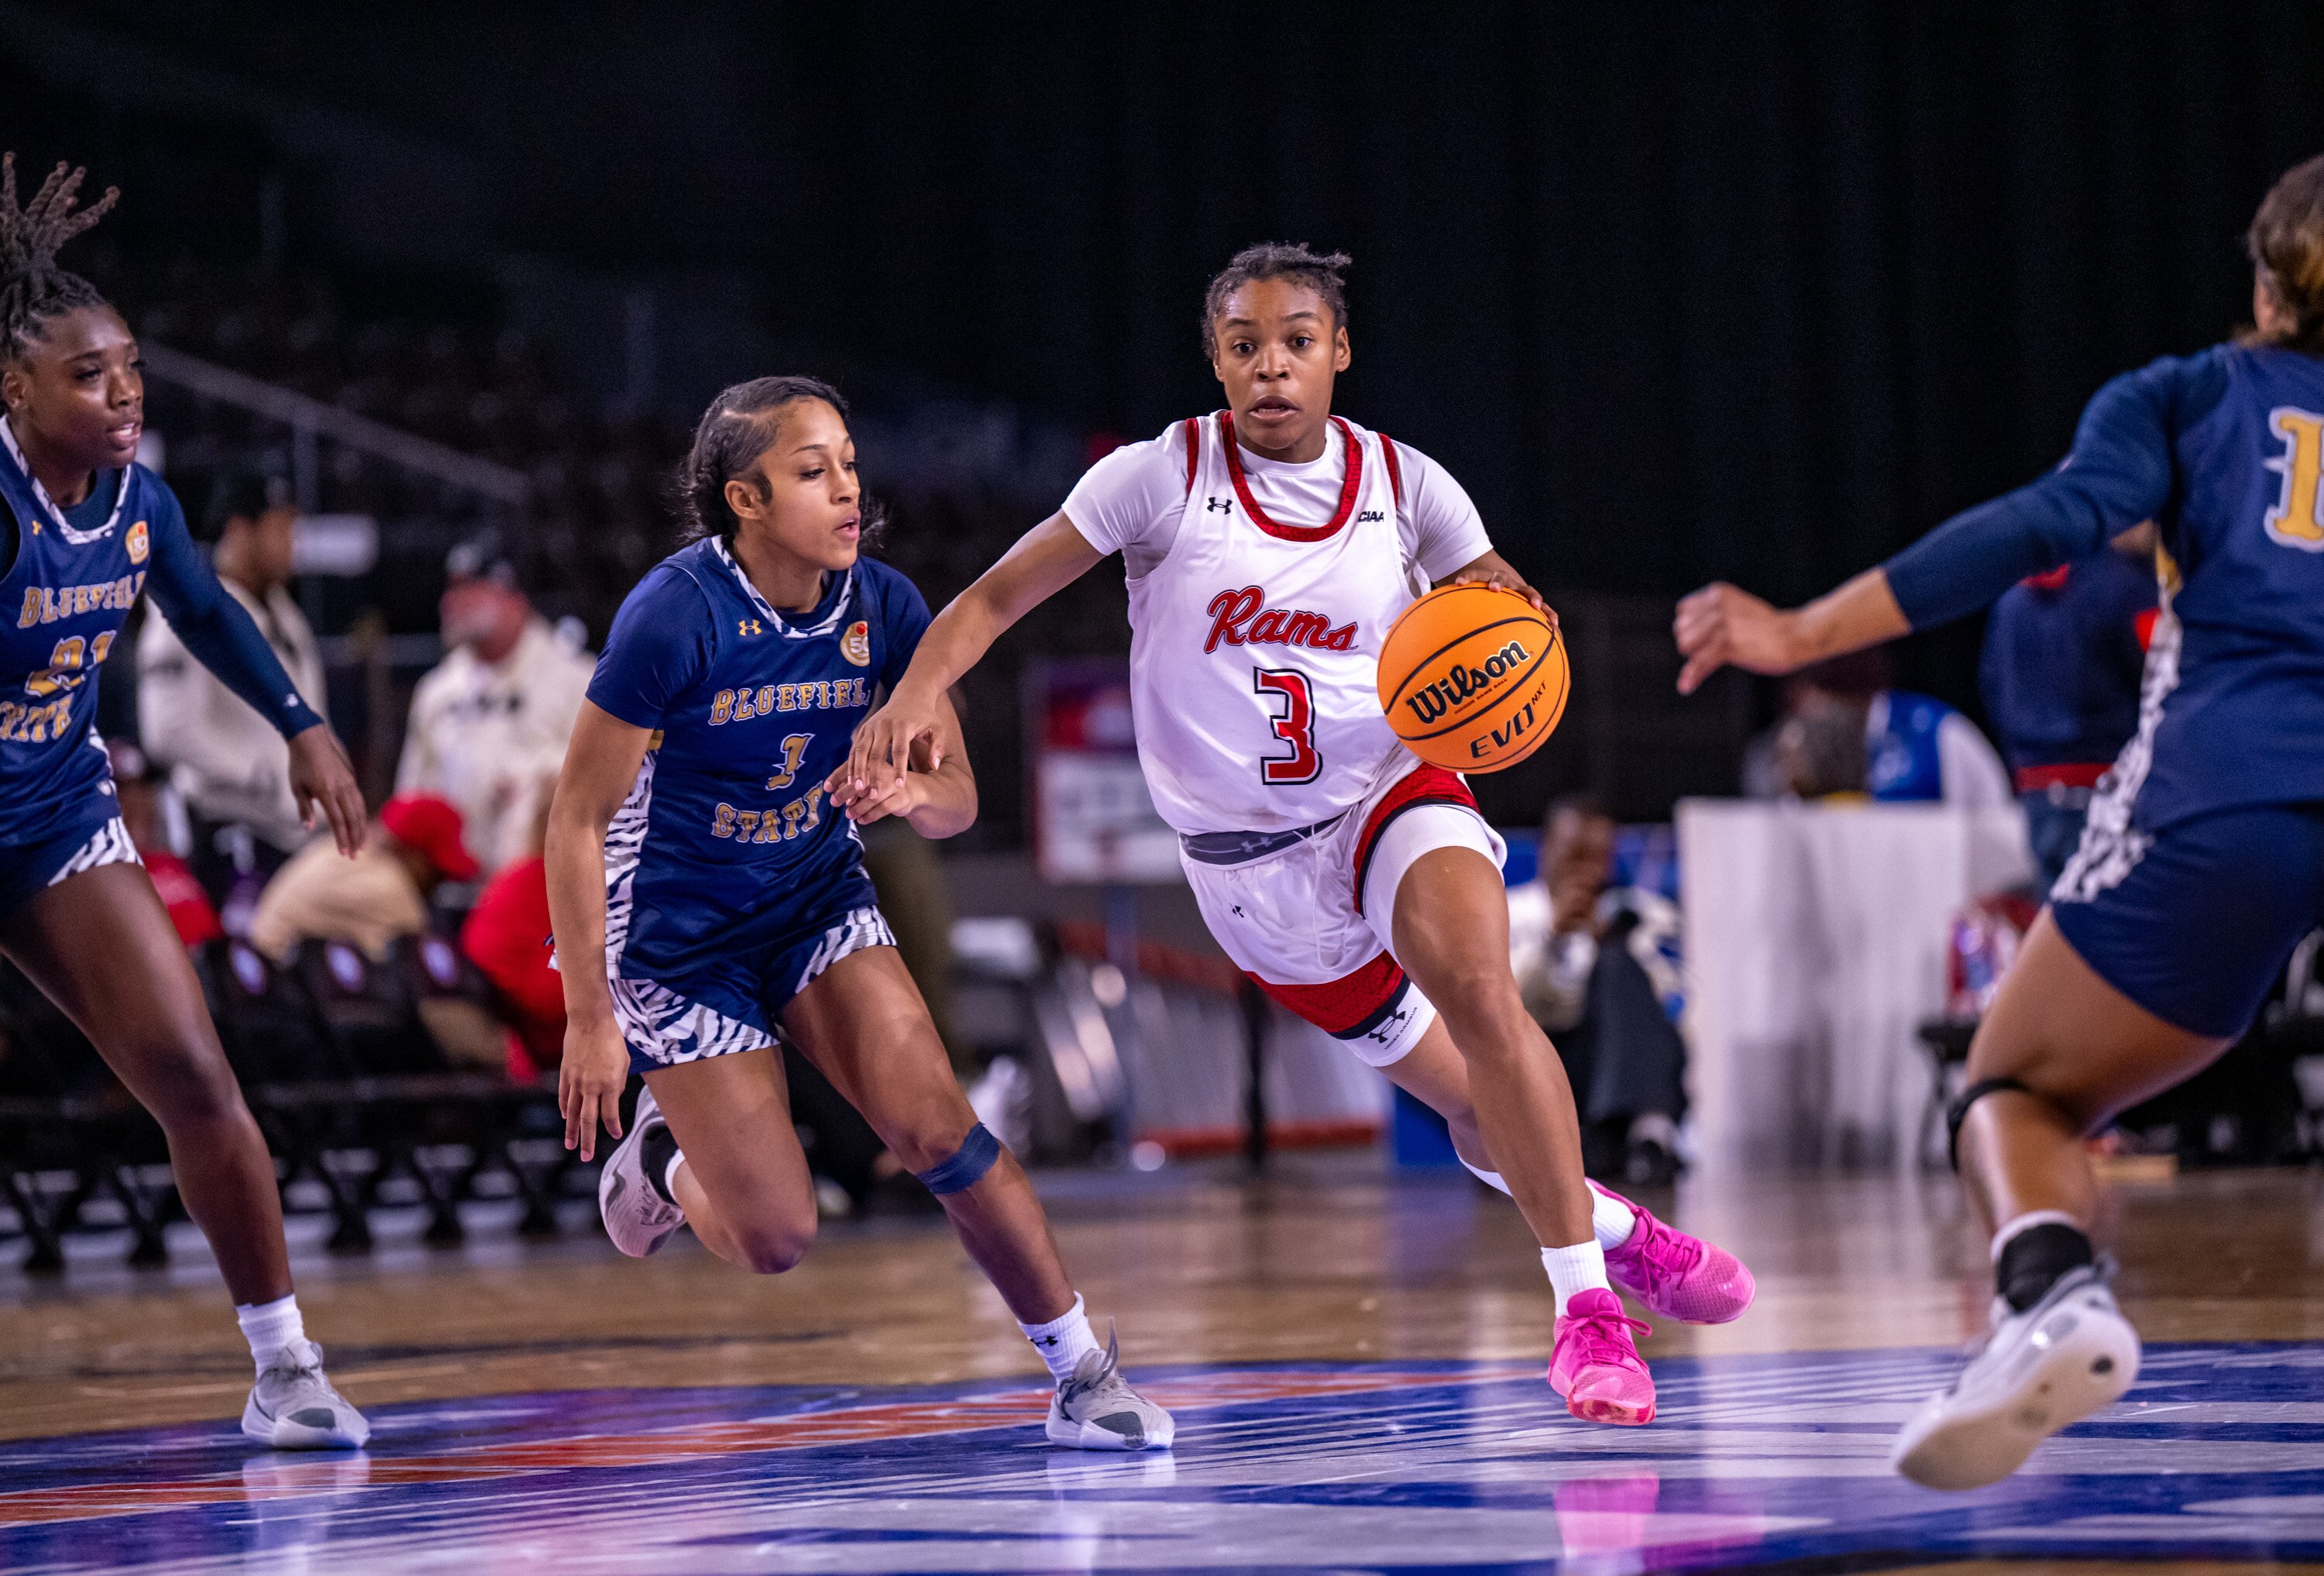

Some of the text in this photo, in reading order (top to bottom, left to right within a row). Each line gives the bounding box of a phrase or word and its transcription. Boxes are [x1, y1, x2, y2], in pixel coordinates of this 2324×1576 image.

[1357, 511, 1384, 522] CIAA
[17, 570, 146, 629] BLUEFIEL
[1204, 585, 1359, 653] Rams
[708, 677, 870, 725] BLUEFIEL
[1405, 640, 1530, 724] Wilson
[1532, 680, 1546, 705] NXT
[1253, 666, 1323, 785] 3
[1384, 1034, 1400, 1050] UNDER
